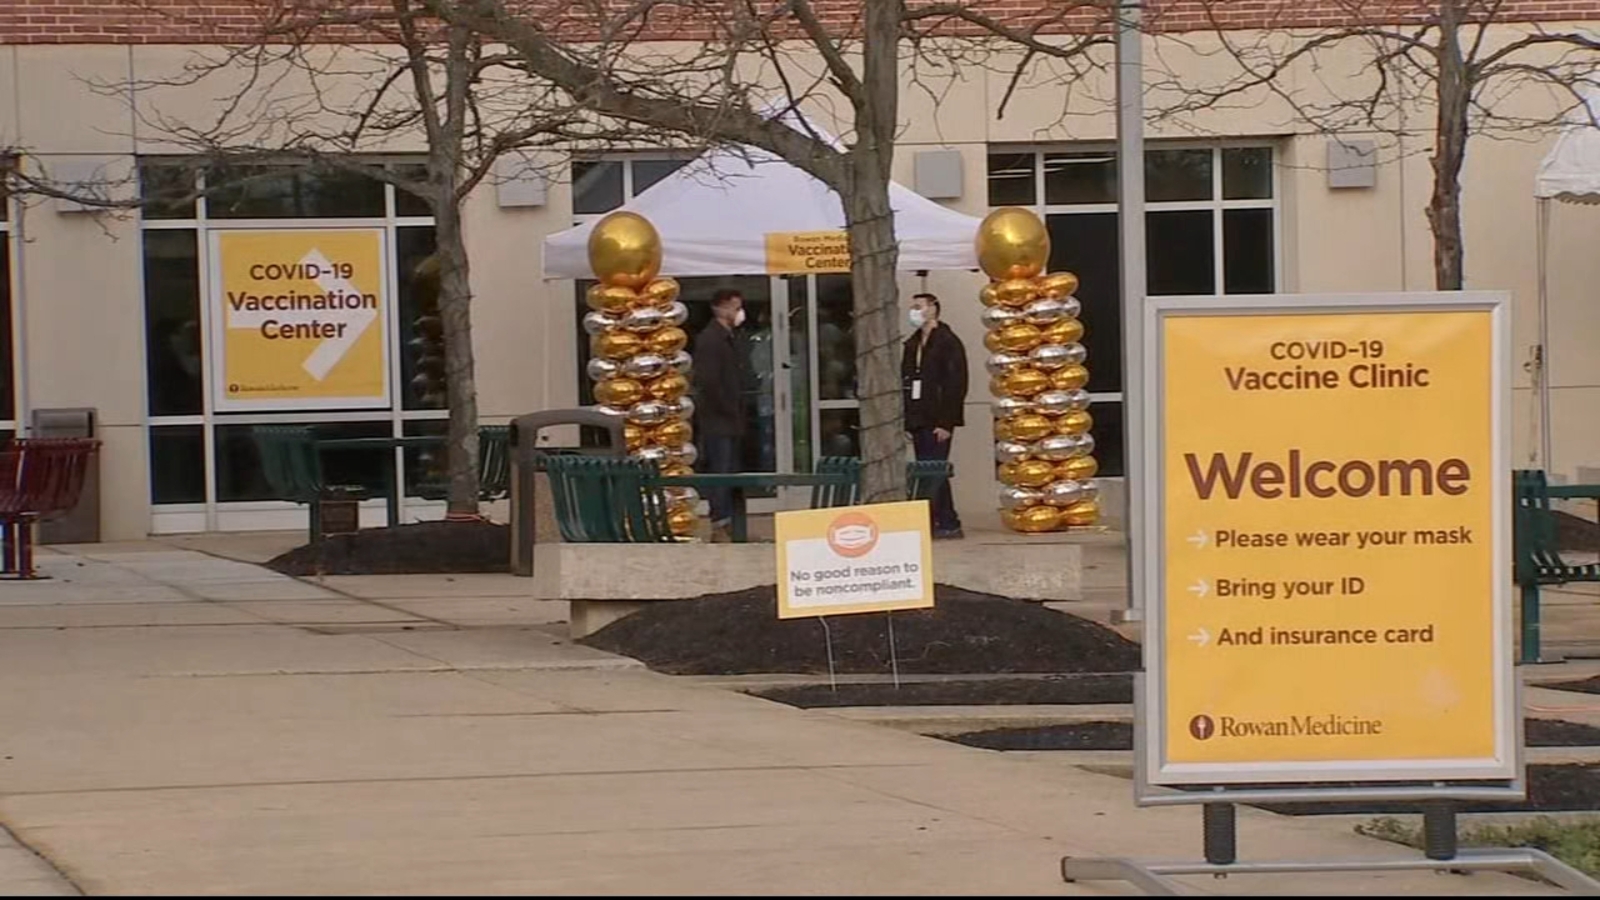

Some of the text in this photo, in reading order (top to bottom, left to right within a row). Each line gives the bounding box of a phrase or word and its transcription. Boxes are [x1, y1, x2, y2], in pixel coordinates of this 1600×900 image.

[788, 243, 849, 256] Vaccinat
[250, 263, 353, 280] COVID-19
[227, 290, 377, 311] Vaccination
[260, 319, 347, 339] Center
[1270, 340, 1383, 360] COVID-19
[1224, 363, 1429, 390] Vaccine Clinic
[1183, 449, 1470, 500] Welcome
[1215, 526, 1472, 549] Please wear your mask
[790, 561, 919, 582] No good reason to
[794, 585, 813, 597] be
[1216, 577, 1365, 599] Bring your ID
[1217, 624, 1434, 645] And insurance card
